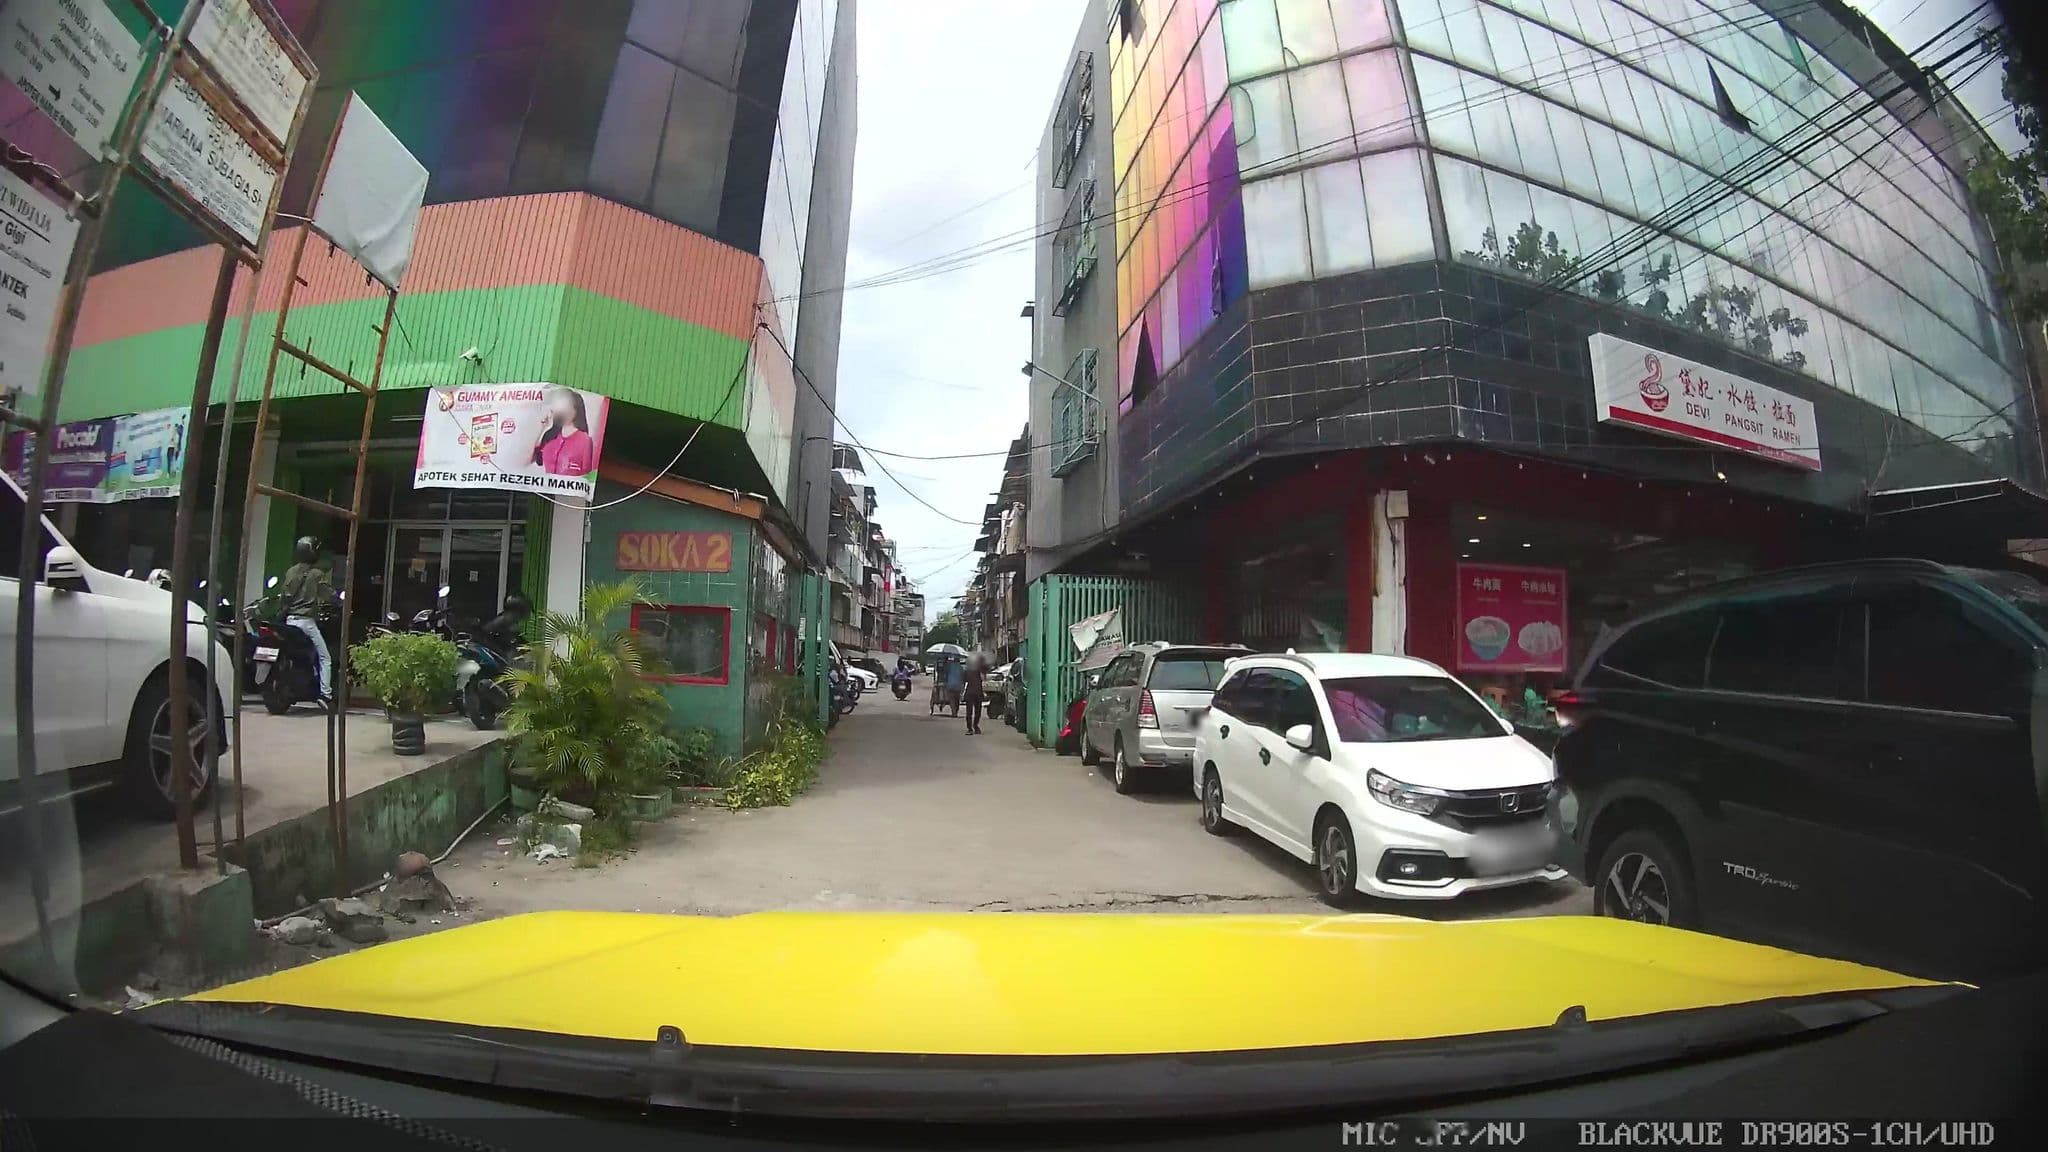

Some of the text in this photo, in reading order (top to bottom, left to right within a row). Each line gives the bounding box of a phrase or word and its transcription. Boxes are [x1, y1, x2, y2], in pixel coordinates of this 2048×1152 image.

[5, 222, 27, 245] Gigi
[0, 269, 29, 299] KTEK
[458, 390, 544, 402] GUMMY ANEMIA
[1686, 402, 1801, 447] DEVI PANGSIT RAMEN
[418, 472, 458, 482] APOTEK
[461, 472, 497, 483] SEHAT
[500, 474, 544, 487] REZEKI
[619, 533, 730, 569] SOKA 2
